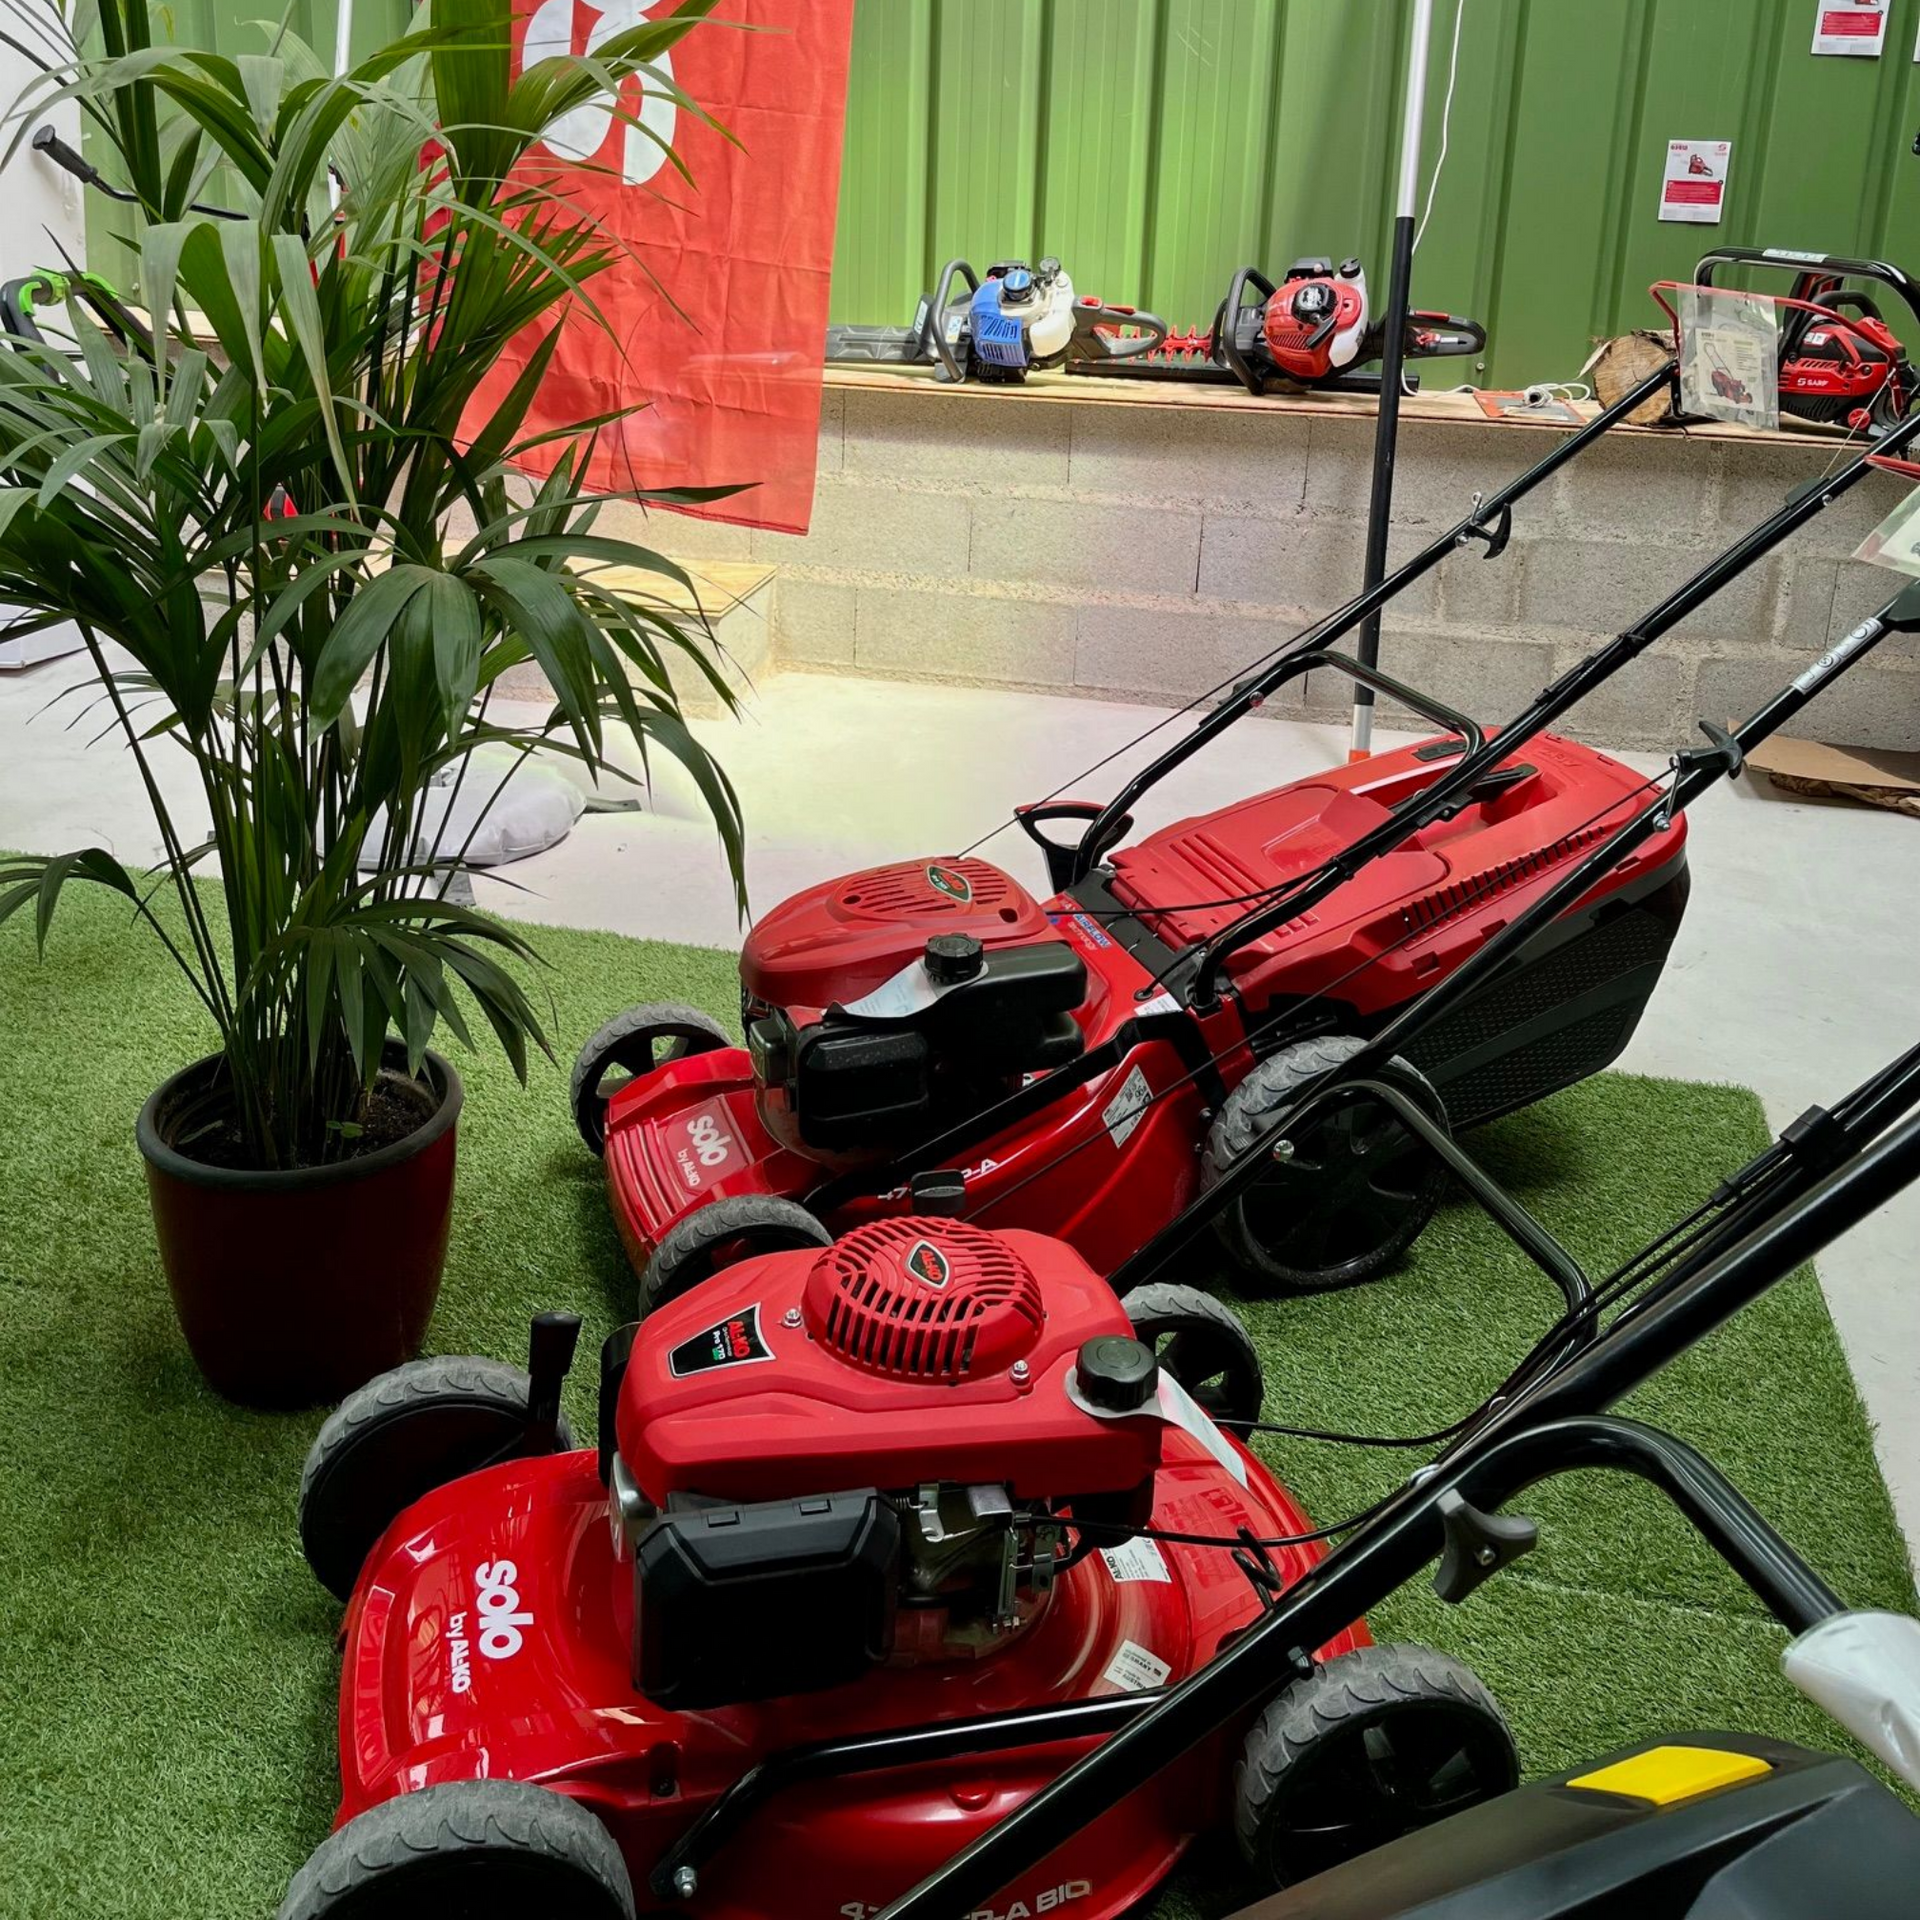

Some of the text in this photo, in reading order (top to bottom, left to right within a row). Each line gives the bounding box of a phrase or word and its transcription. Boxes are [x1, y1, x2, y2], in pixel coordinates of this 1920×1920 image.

[687, 1115, 732, 1166] solo
[677, 1148, 701, 1187] by AL-KO
[919, 1249, 943, 1281] AL-KO
[727, 1321, 751, 1358] AL-KO
[1106, 1556, 1124, 1580] AL-KO
[475, 1559, 534, 1660] solo
[445, 1611, 472, 1694] by AL-KO
[1036, 1879, 1093, 1913] BIO
